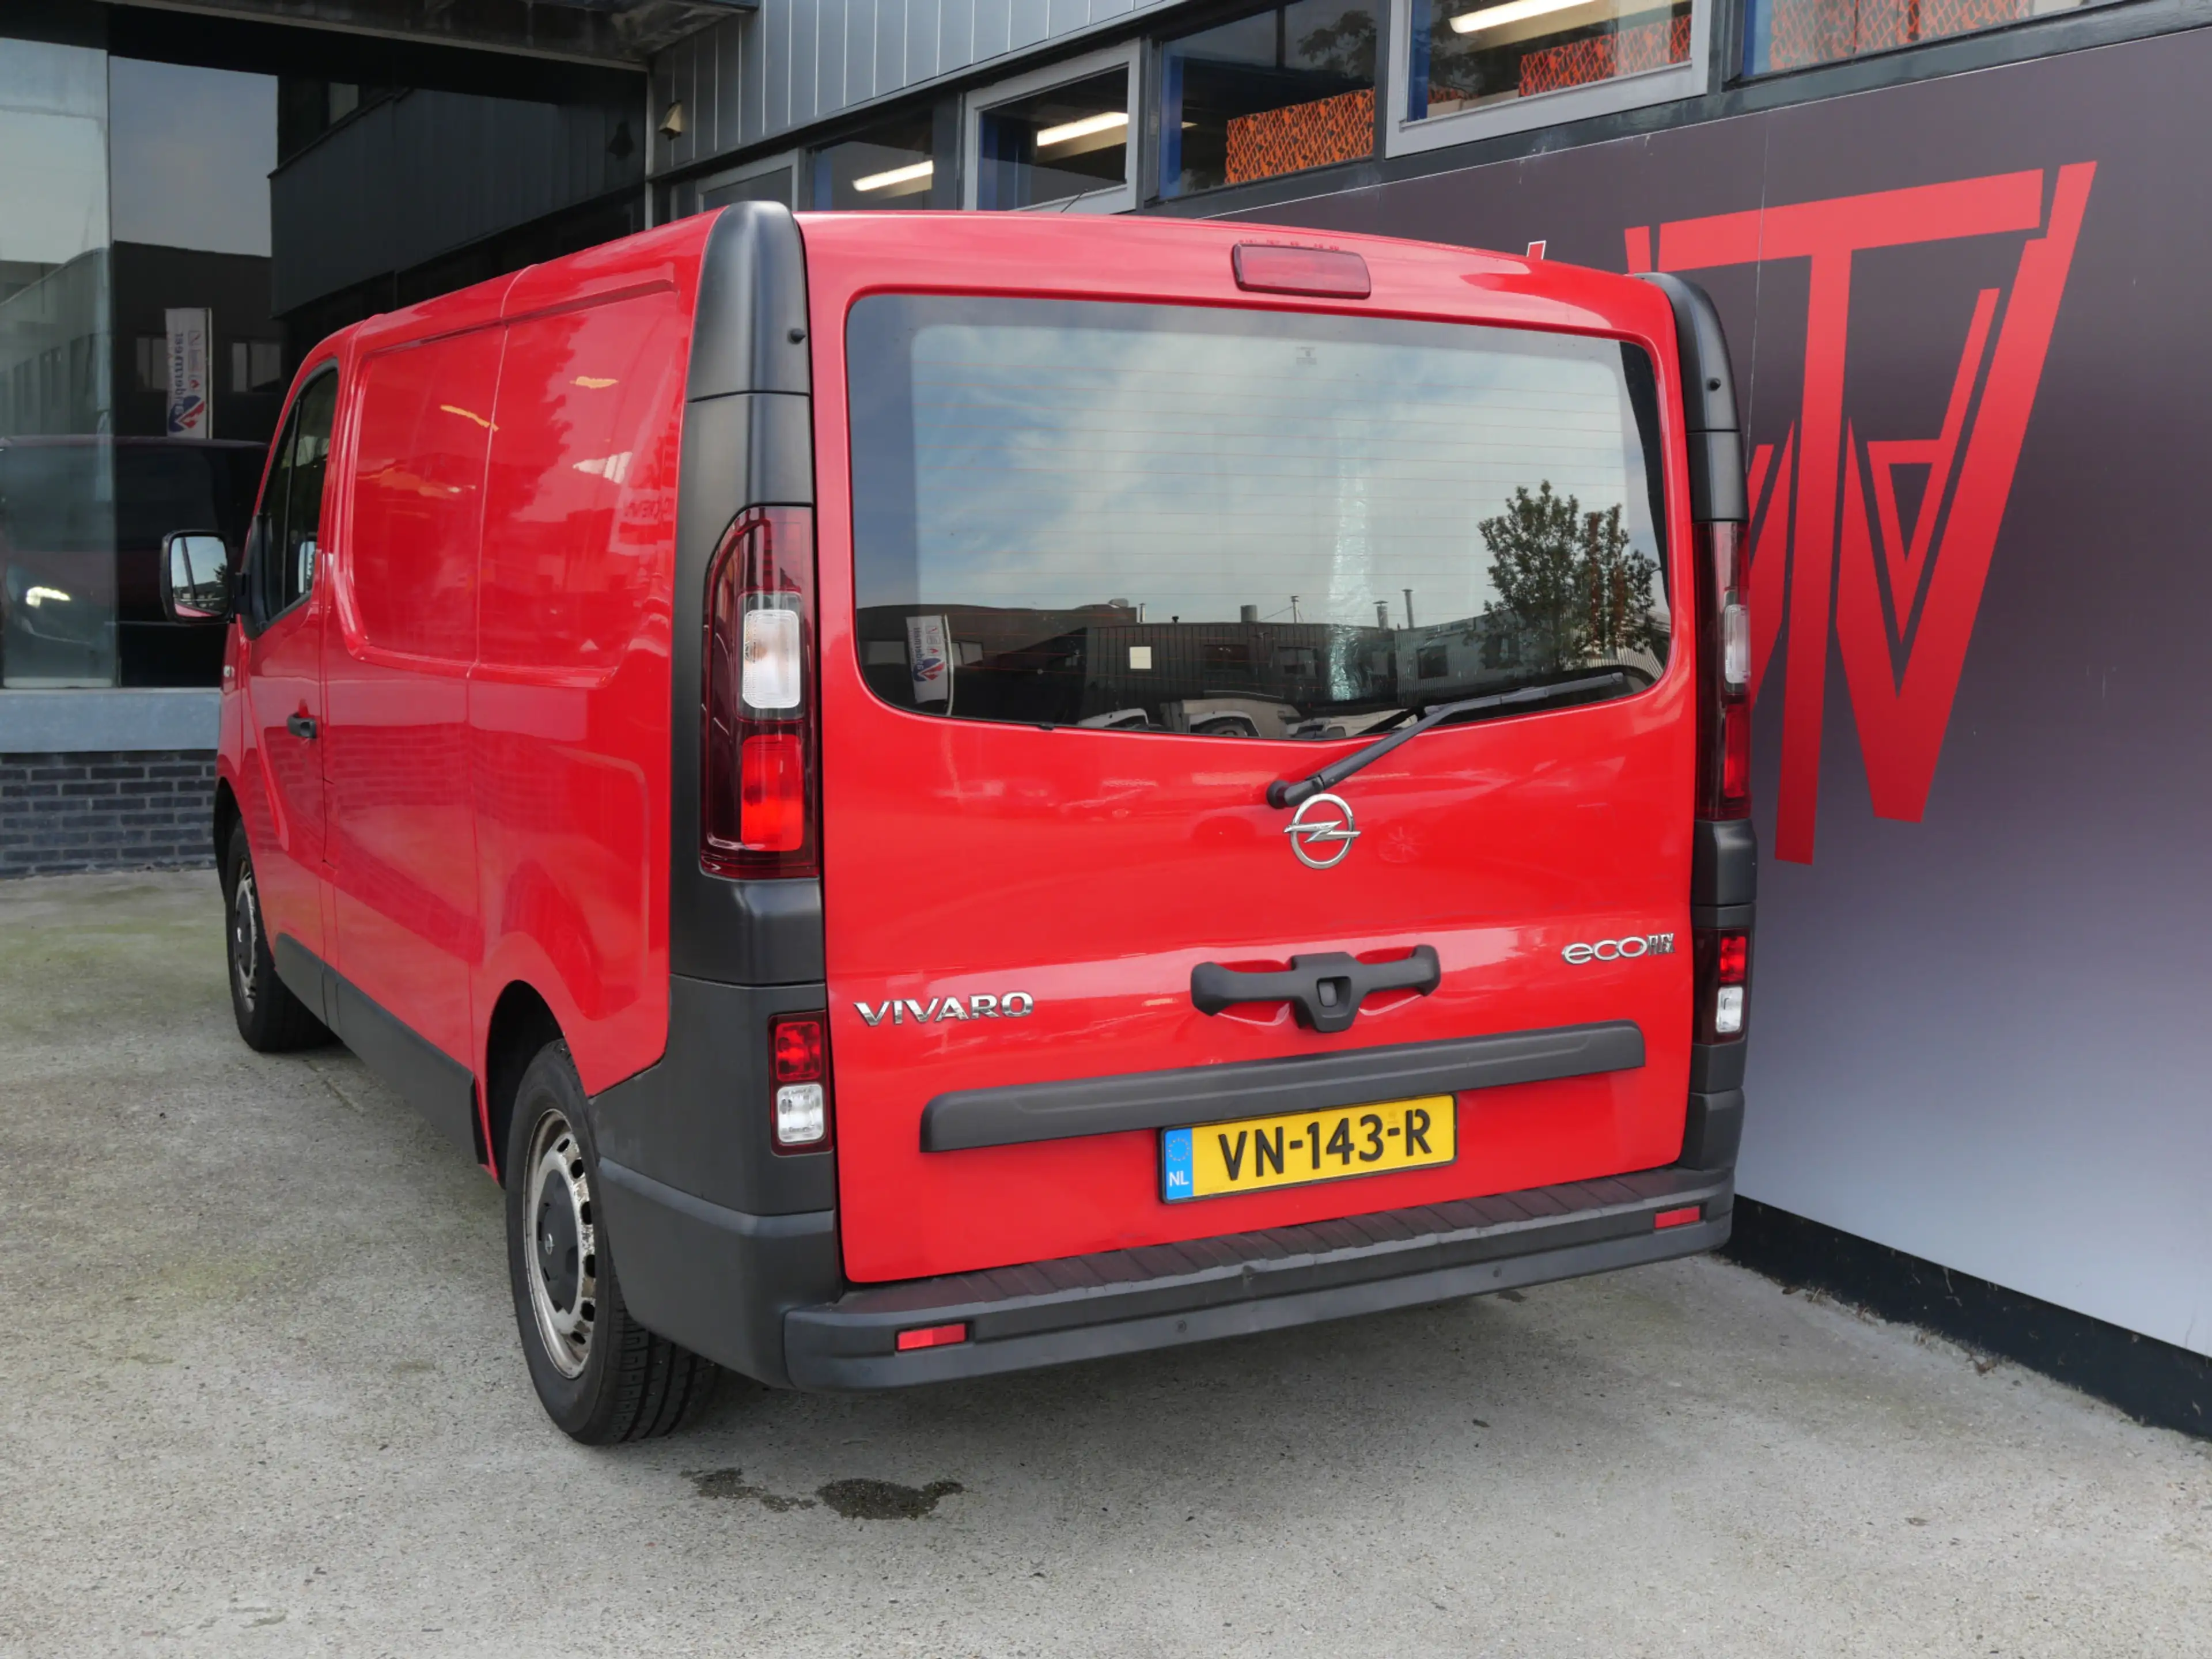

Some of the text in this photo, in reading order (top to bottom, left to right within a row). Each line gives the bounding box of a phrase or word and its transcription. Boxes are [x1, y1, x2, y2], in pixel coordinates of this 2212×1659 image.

[853, 991, 1035, 1027] VIVARO
[1218, 1108, 1432, 1181] VN-143-R
[1169, 1171, 1190, 1187] NL
